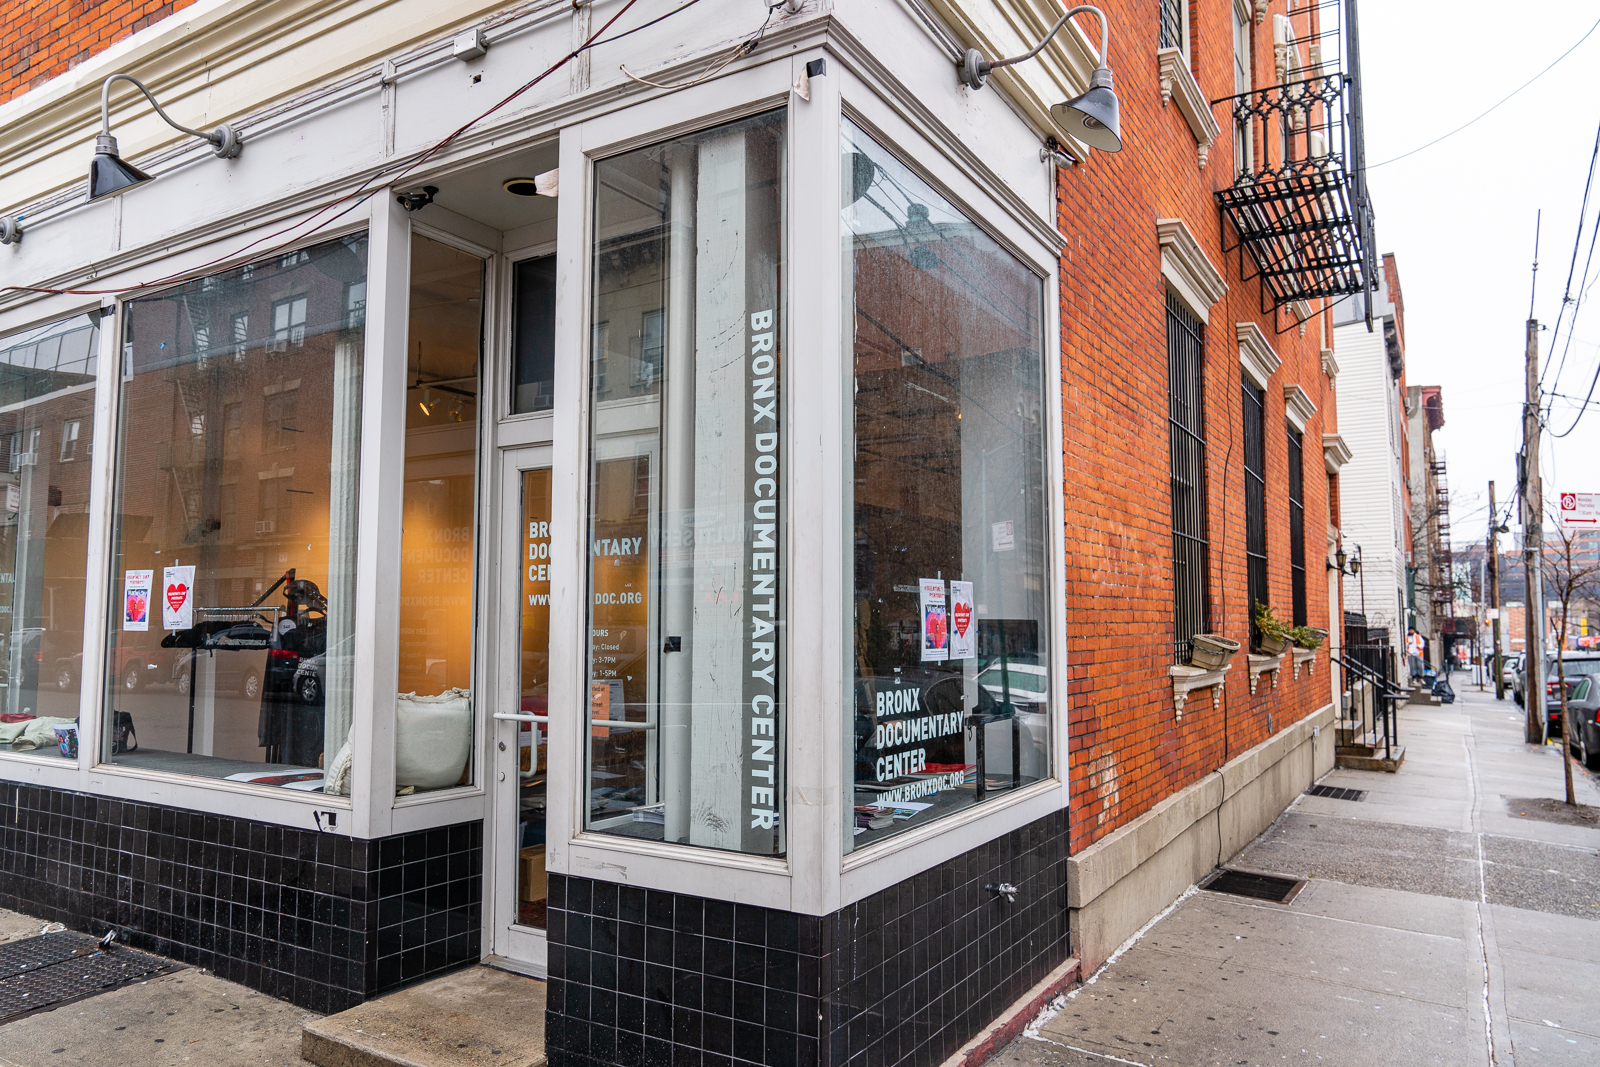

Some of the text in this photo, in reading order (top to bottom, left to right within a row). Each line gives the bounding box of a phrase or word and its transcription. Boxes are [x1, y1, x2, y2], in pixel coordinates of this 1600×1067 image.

[750, 309, 778, 830] BRONX DOCUMENTARY CENTER
[592, 592, 642, 605] DOC.ORG
[598, 656, 616, 664] 3-7PM
[601, 643, 620, 651] Closed
[599, 669, 617, 677] 1-5PM
[876, 687, 921, 717] BRONX
[876, 710, 965, 750] DOCUMENTARY
[876, 748, 927, 782] CENTER
[877, 769, 965, 810] WWW.BRONXDOC.ORG
